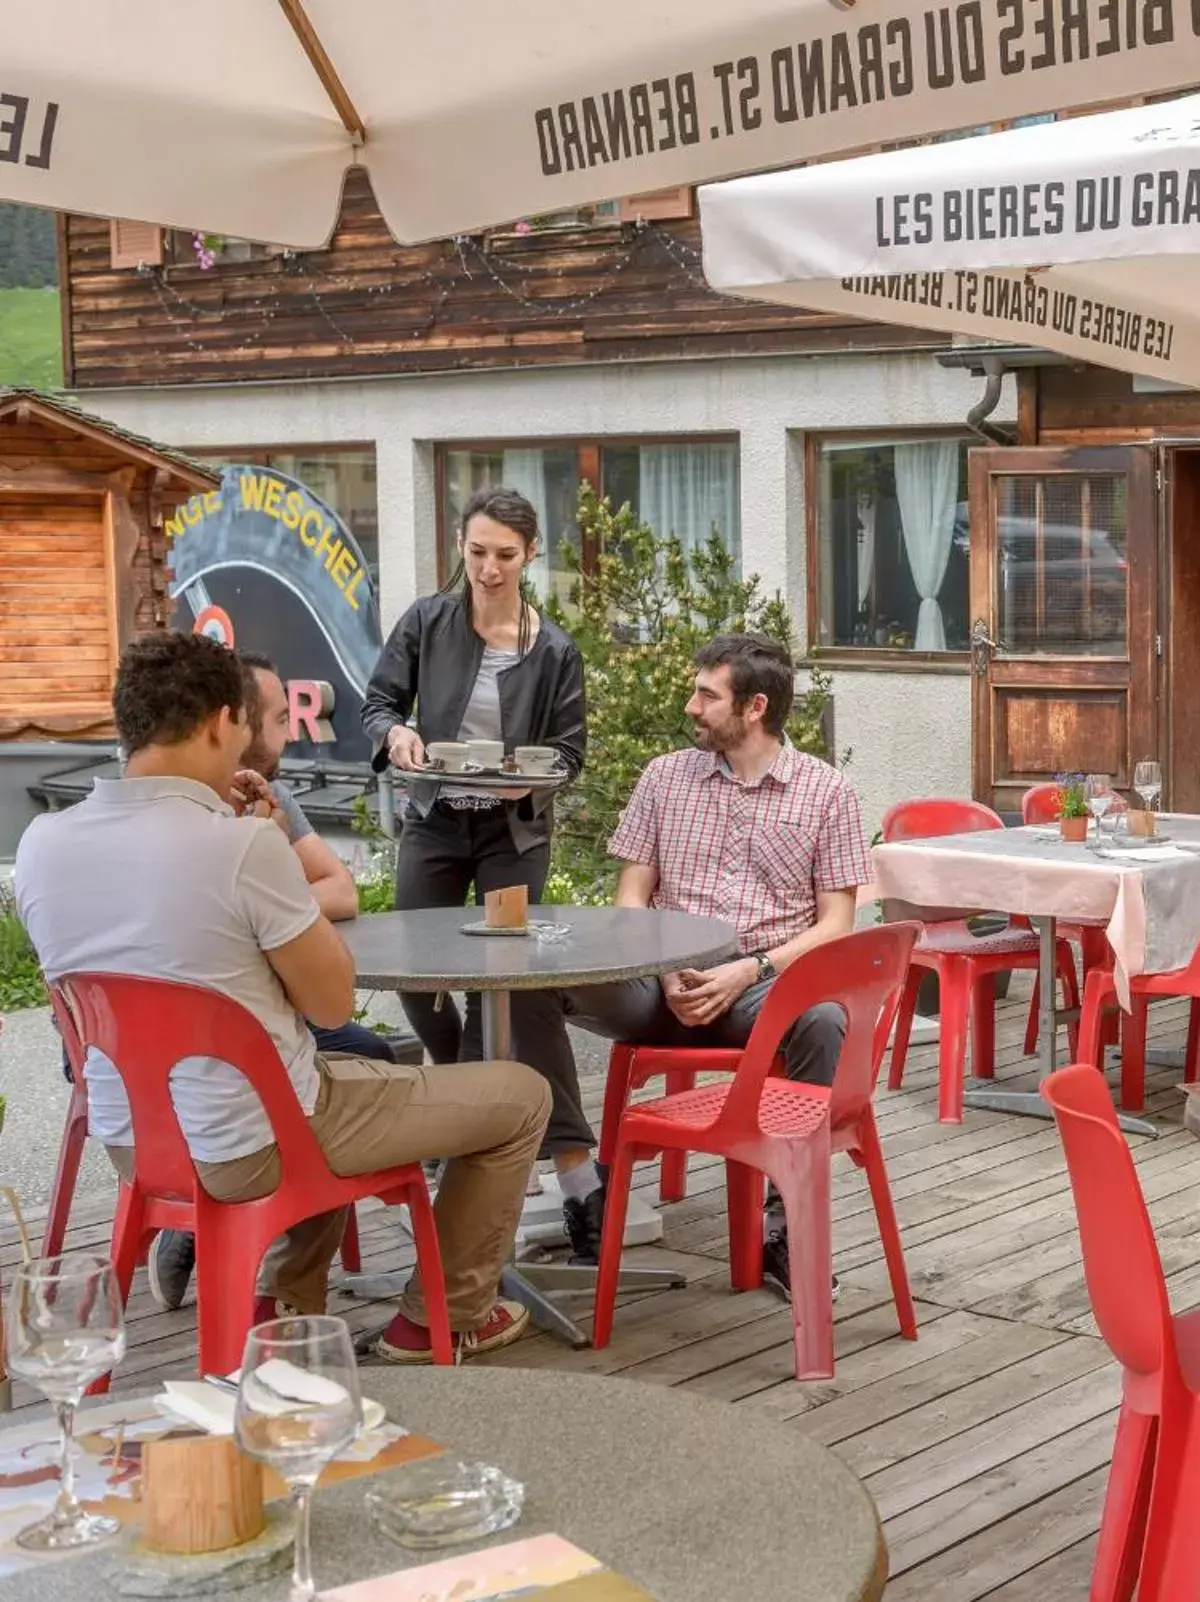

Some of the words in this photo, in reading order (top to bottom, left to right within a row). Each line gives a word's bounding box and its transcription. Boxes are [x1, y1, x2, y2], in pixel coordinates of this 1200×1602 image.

[876, 193, 932, 247] LES
[943, 182, 1065, 242] BIERES
[1075, 176, 1122, 232] DU
[240, 475, 366, 611] WESCHEL
